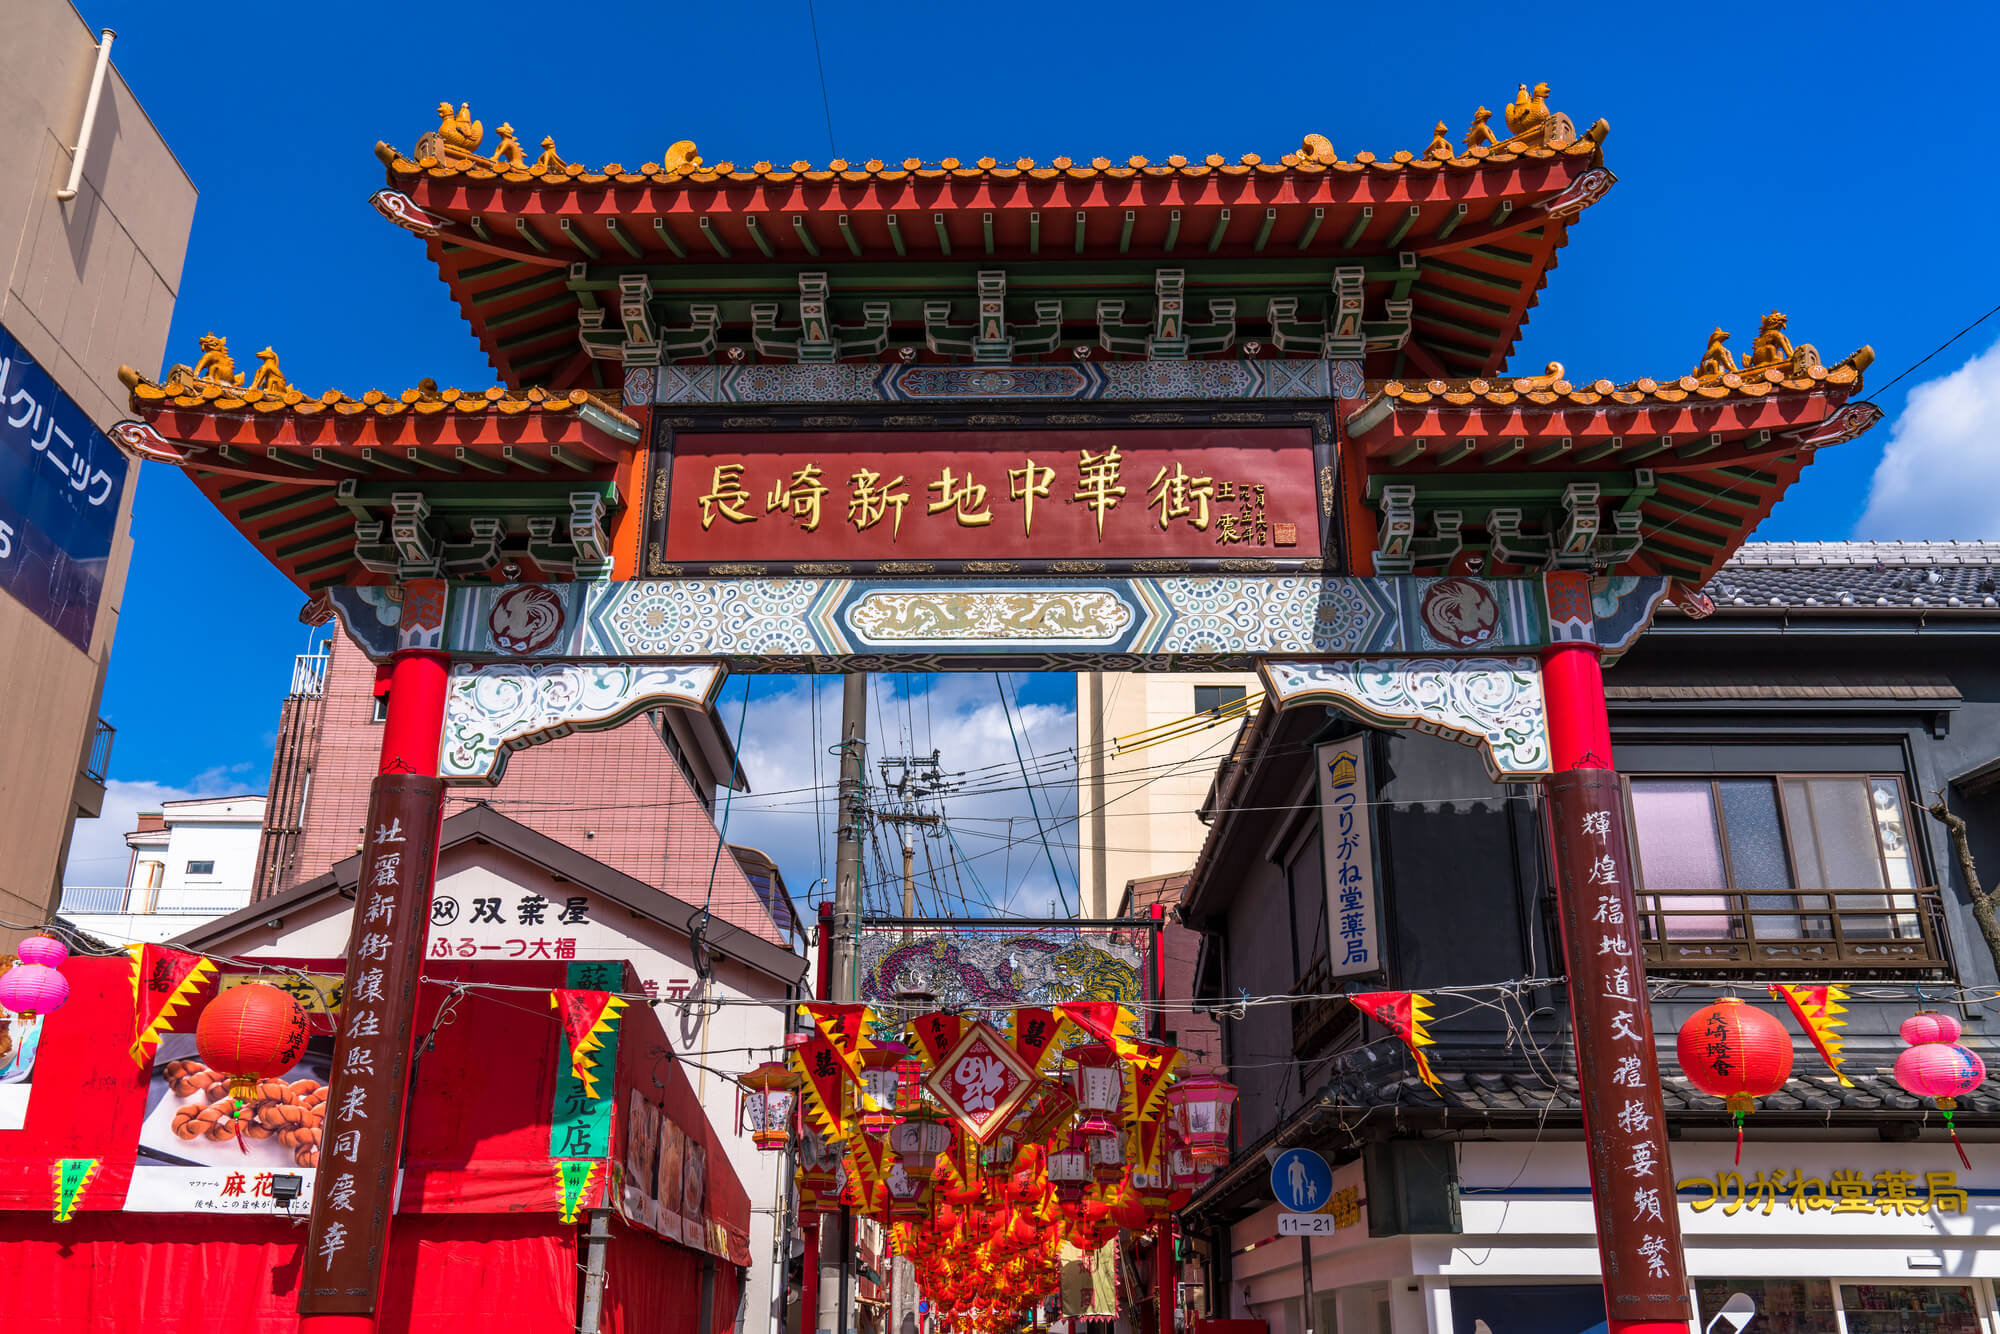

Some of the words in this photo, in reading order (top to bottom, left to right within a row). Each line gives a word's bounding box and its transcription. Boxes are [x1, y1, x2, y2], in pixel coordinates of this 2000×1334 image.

[698, 445, 1214, 542] 長崎新地中華街
[1334, 792, 1368, 966] つりがね堂薬局
[469, 894, 591, 927] 双葉屋
[430, 936, 577, 960] ふるーつ大福
[220, 1171, 303, 1198] 麻花
[1676, 1168, 1969, 1217] つりがね堂薬局
